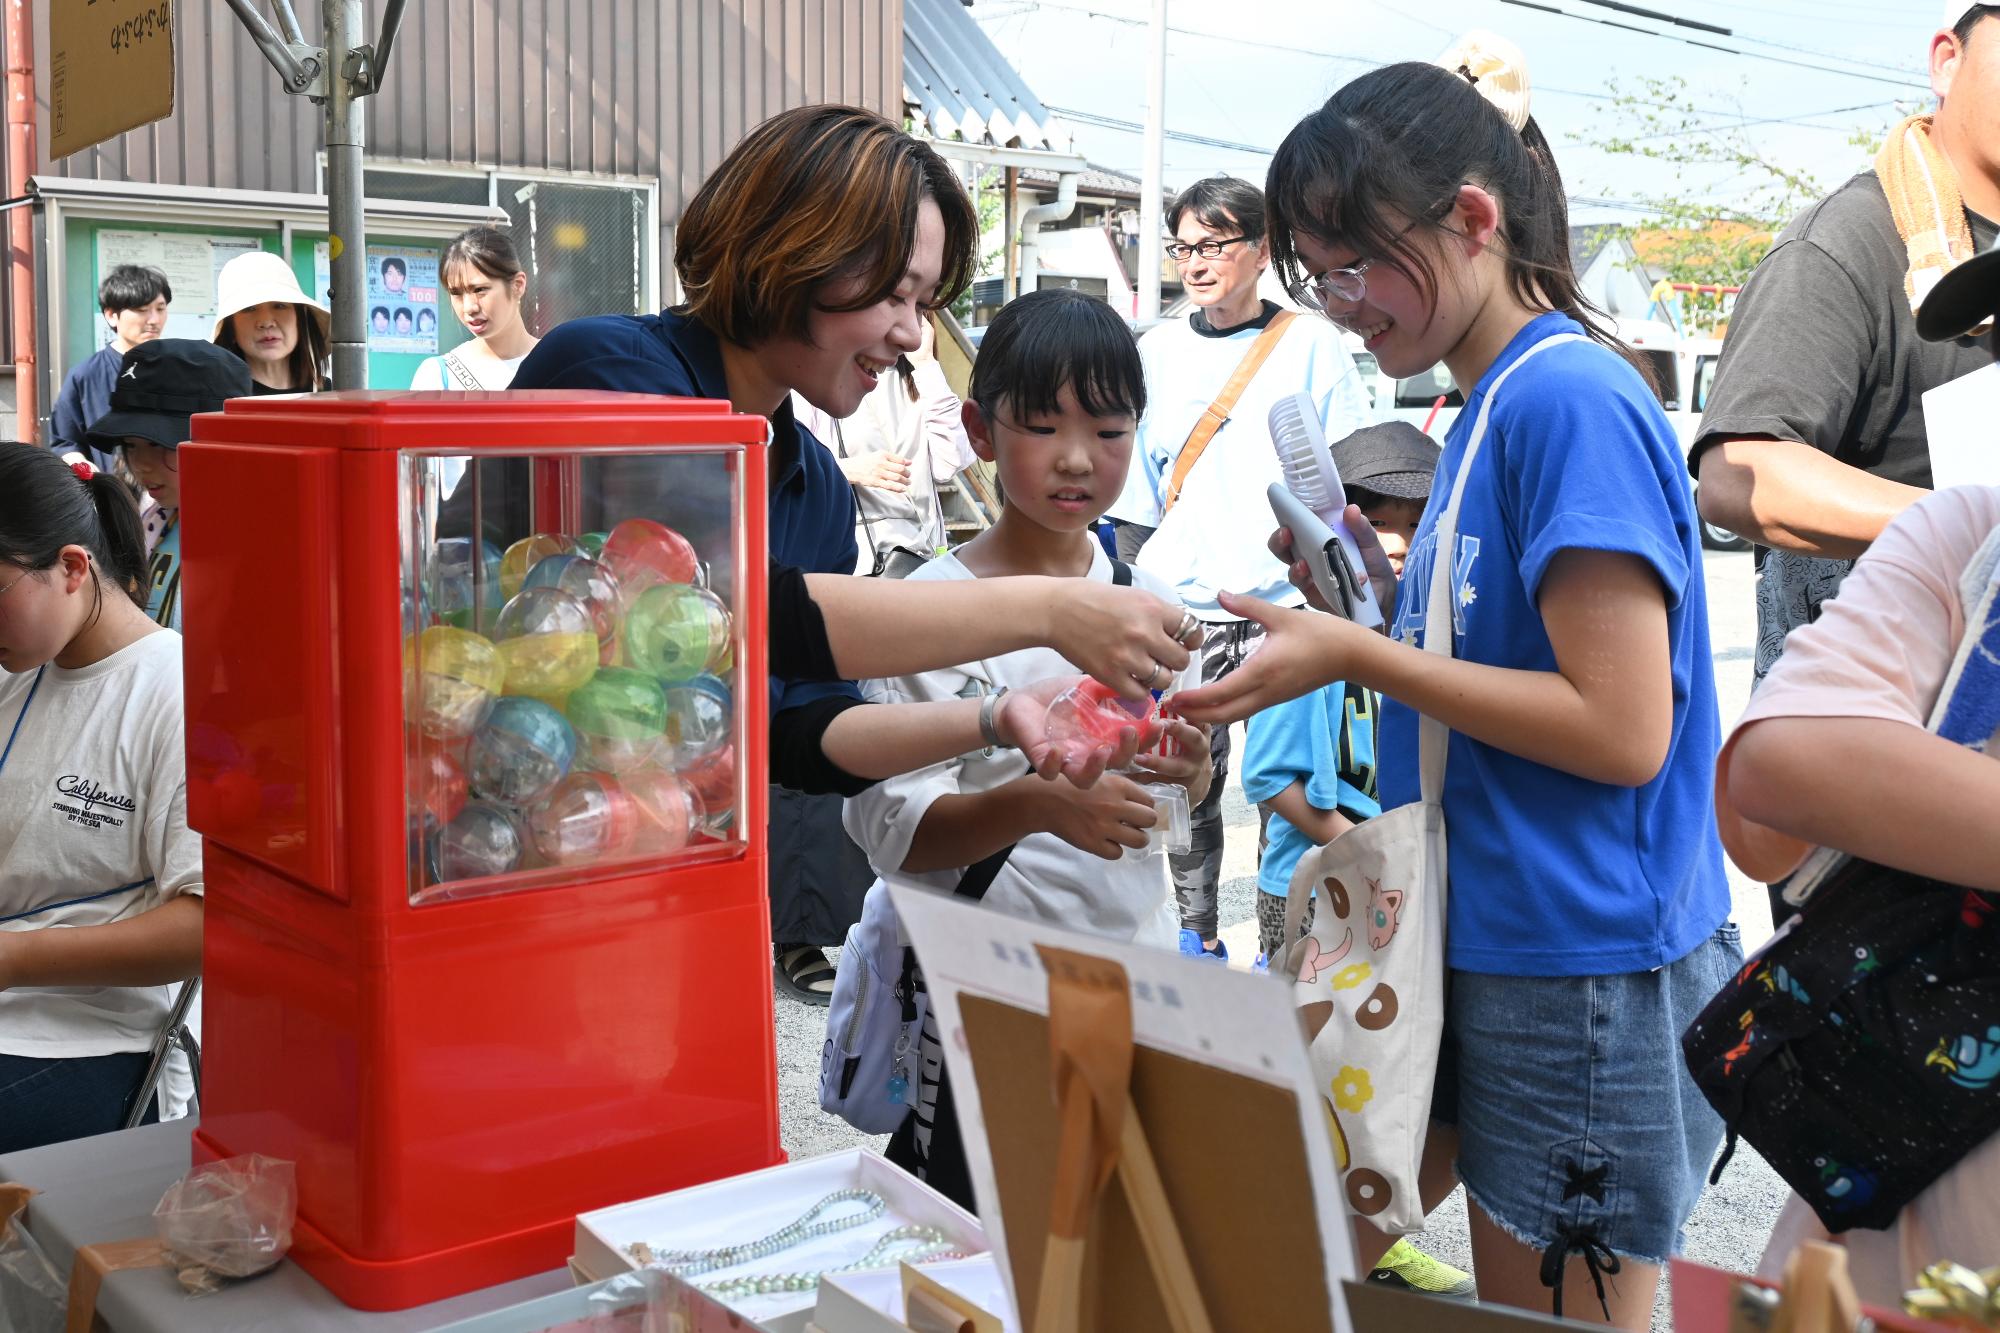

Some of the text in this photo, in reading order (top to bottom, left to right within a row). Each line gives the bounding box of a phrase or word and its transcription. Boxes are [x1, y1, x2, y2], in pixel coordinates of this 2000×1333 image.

[57, 775, 135, 810] California
[52, 802, 123, 827] STANDING MAJESTICALLY
[68, 814, 101, 828] BY THE SEA
